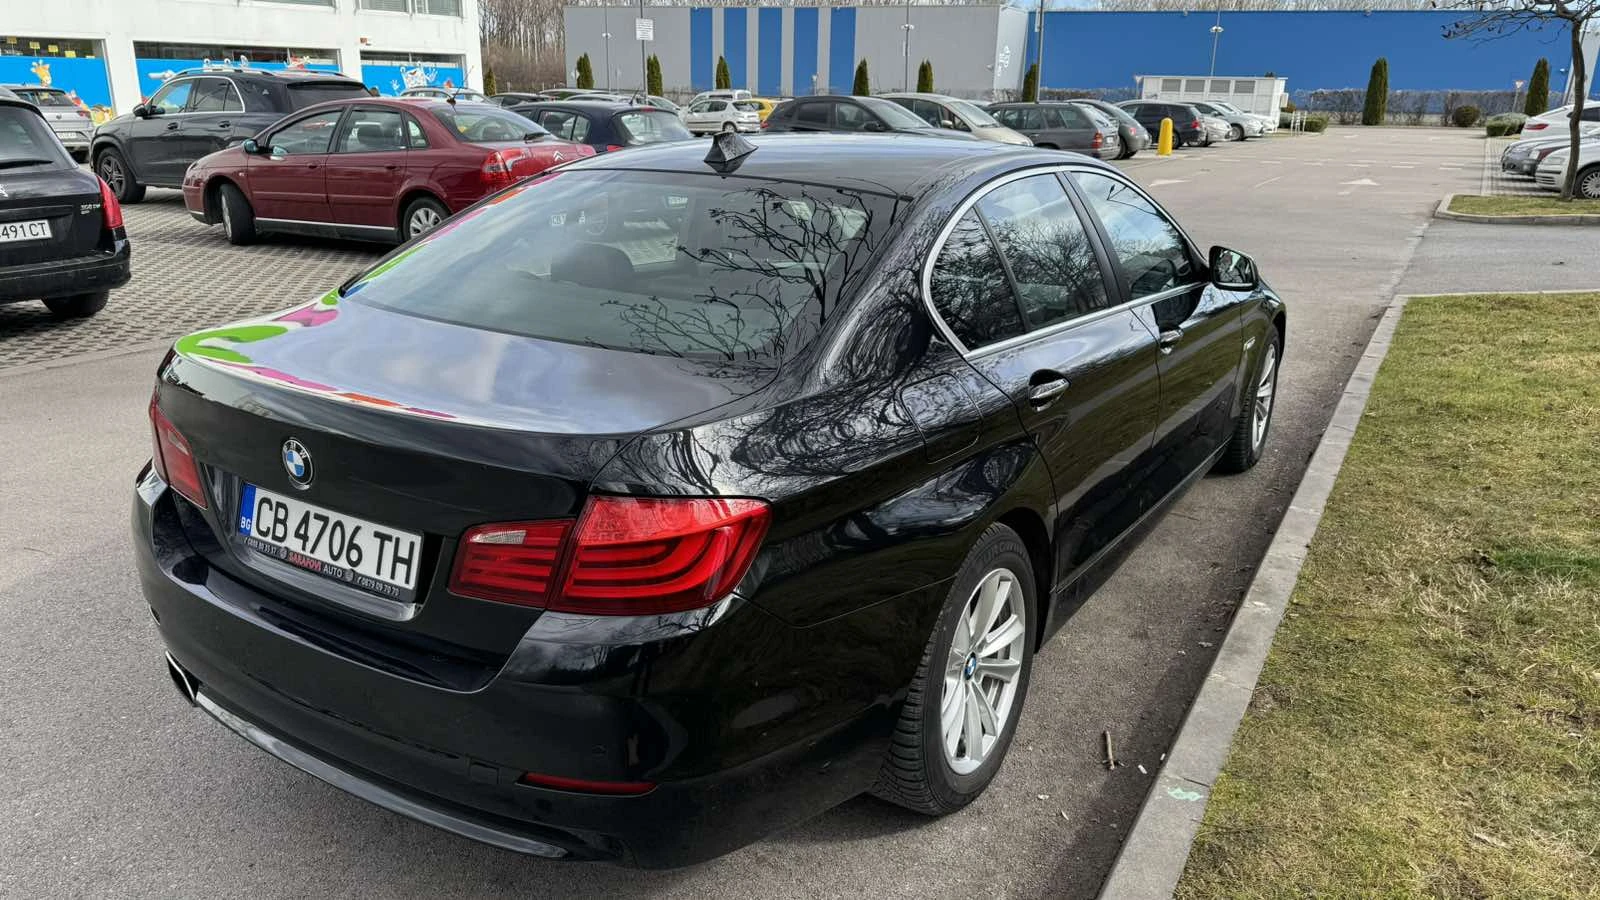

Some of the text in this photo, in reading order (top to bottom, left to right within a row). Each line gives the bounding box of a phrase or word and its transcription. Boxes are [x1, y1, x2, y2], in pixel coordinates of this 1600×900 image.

[0, 222, 46, 239] 491 CT
[240, 516, 252, 530] BG
[255, 497, 415, 585] CB 4706 TH
[323, 563, 343, 578] AUTO
